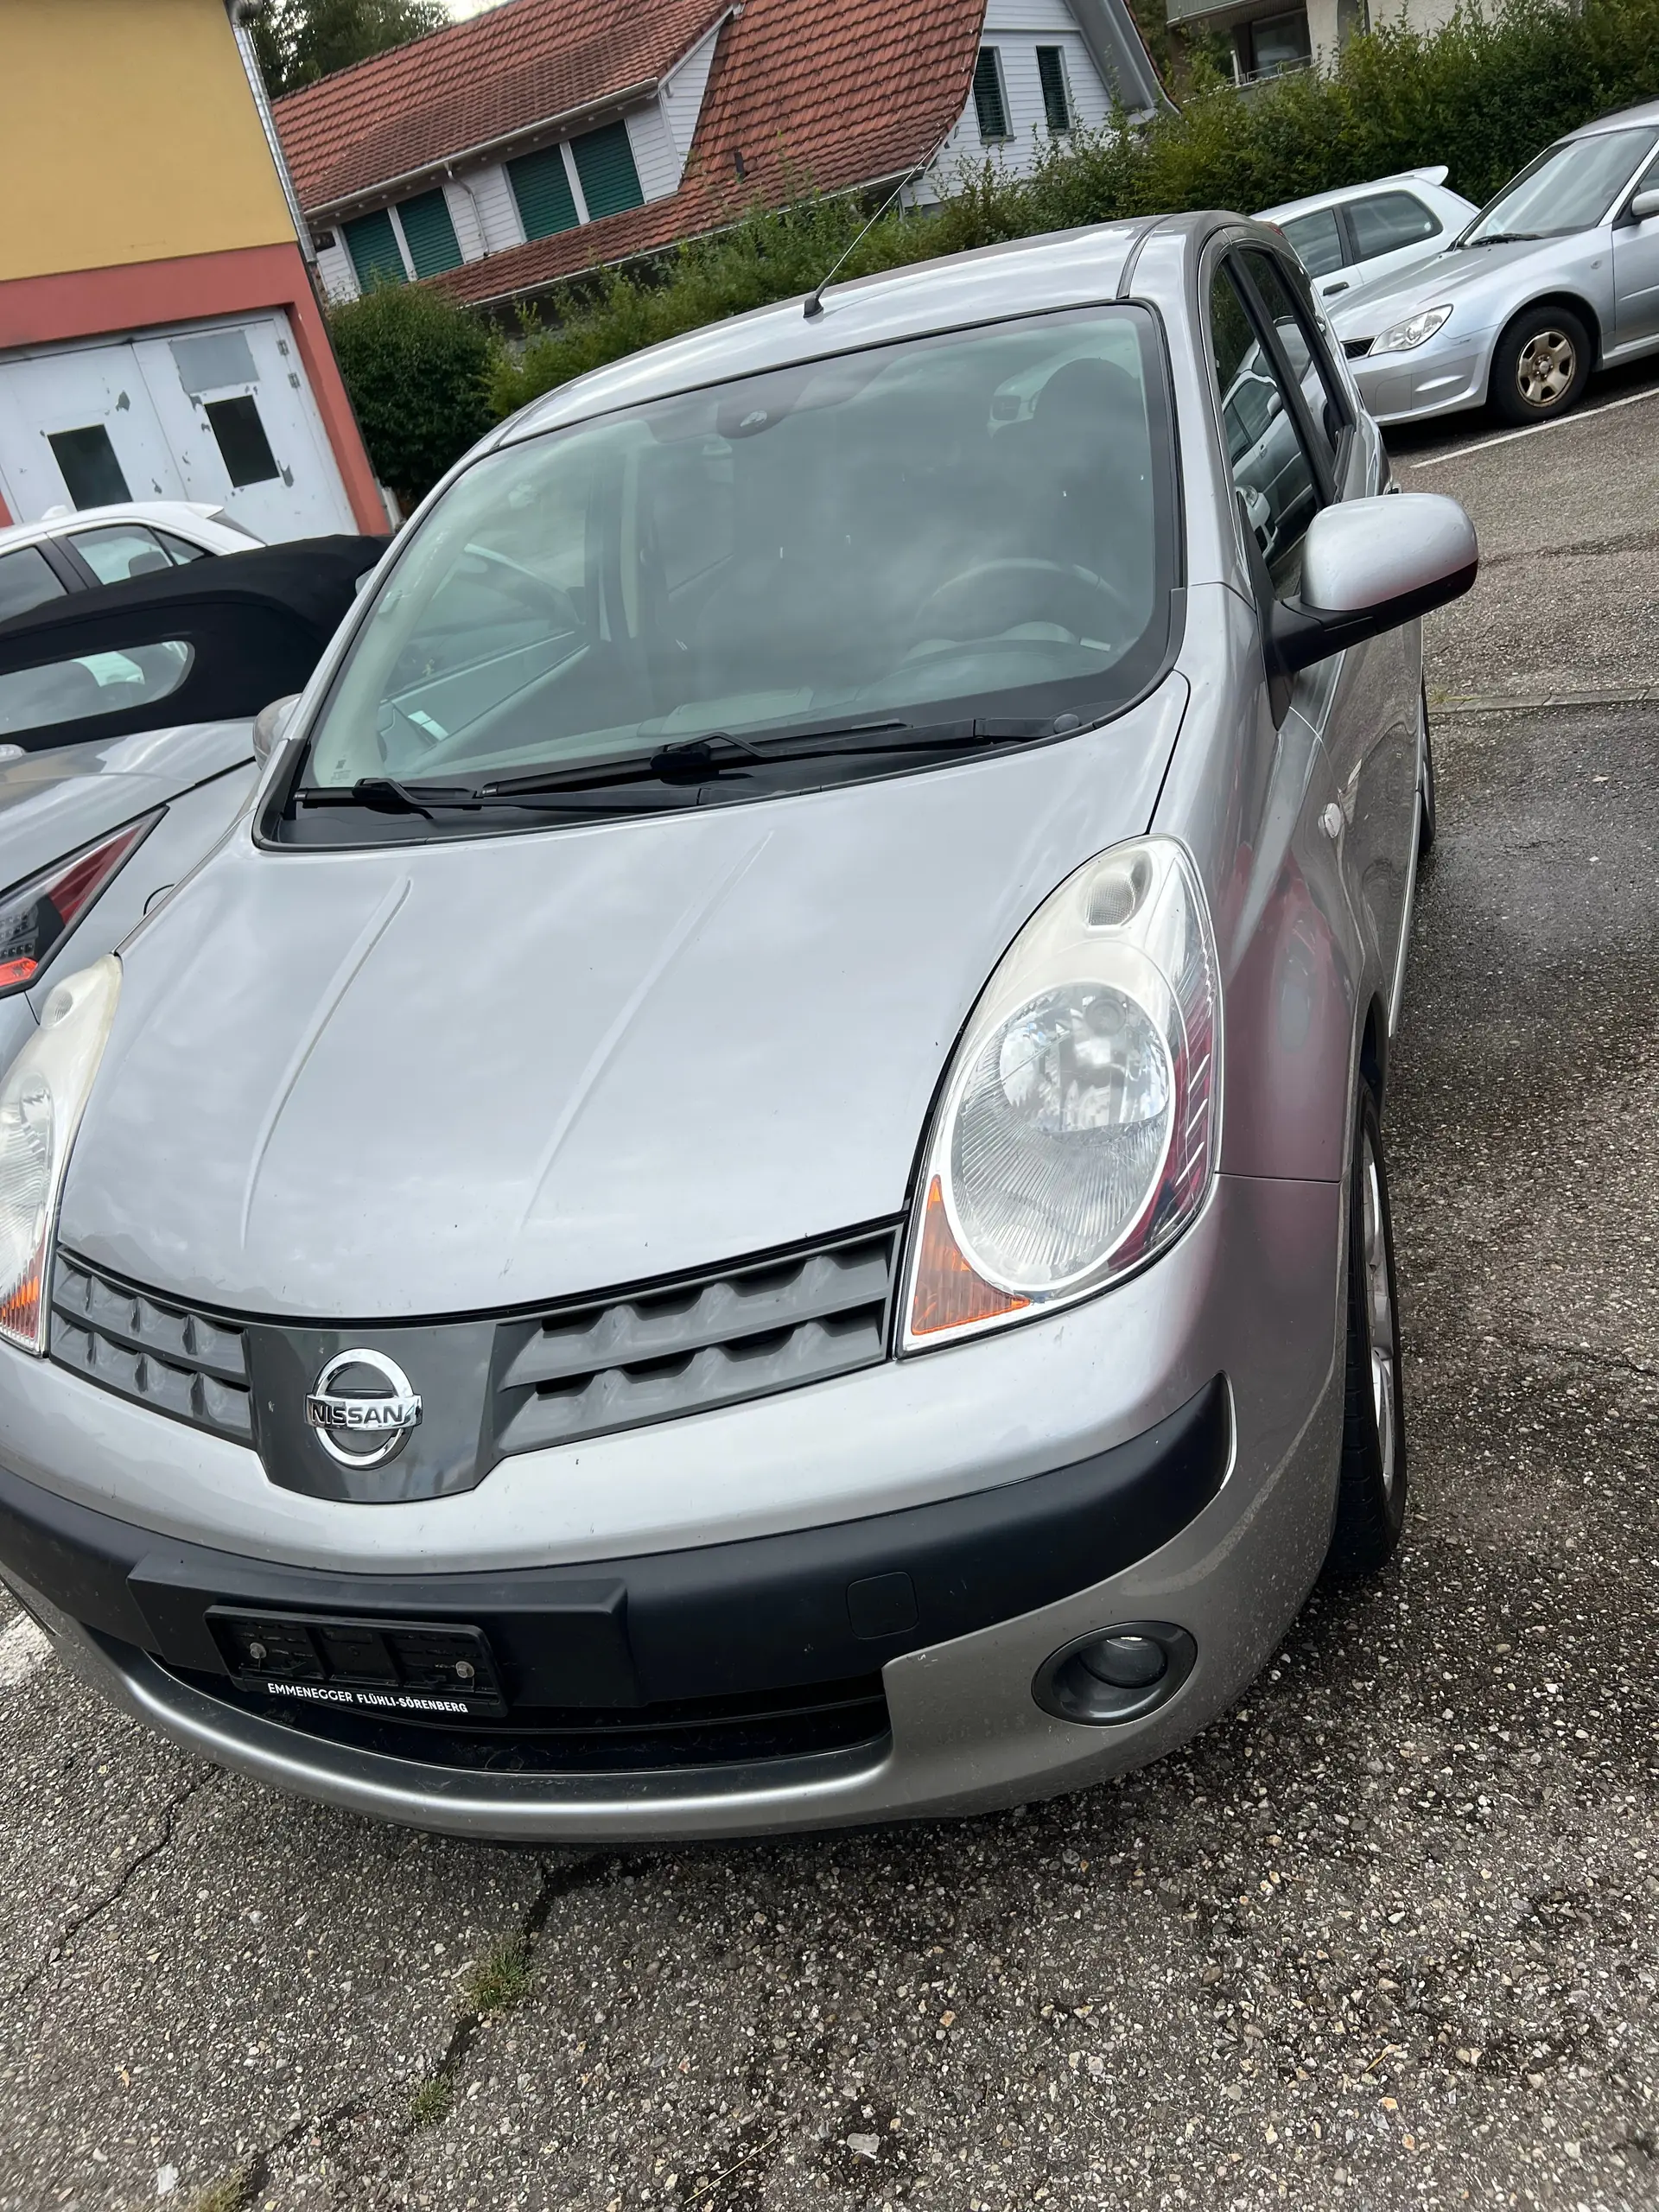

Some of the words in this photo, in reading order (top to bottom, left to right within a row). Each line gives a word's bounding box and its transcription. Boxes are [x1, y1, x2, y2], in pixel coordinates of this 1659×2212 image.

[312, 1403, 404, 1425] NISSAN
[267, 1682, 353, 1702] EMMENEGGER
[356, 1693, 468, 1713] FLÜHLI-SÖRENBERG
